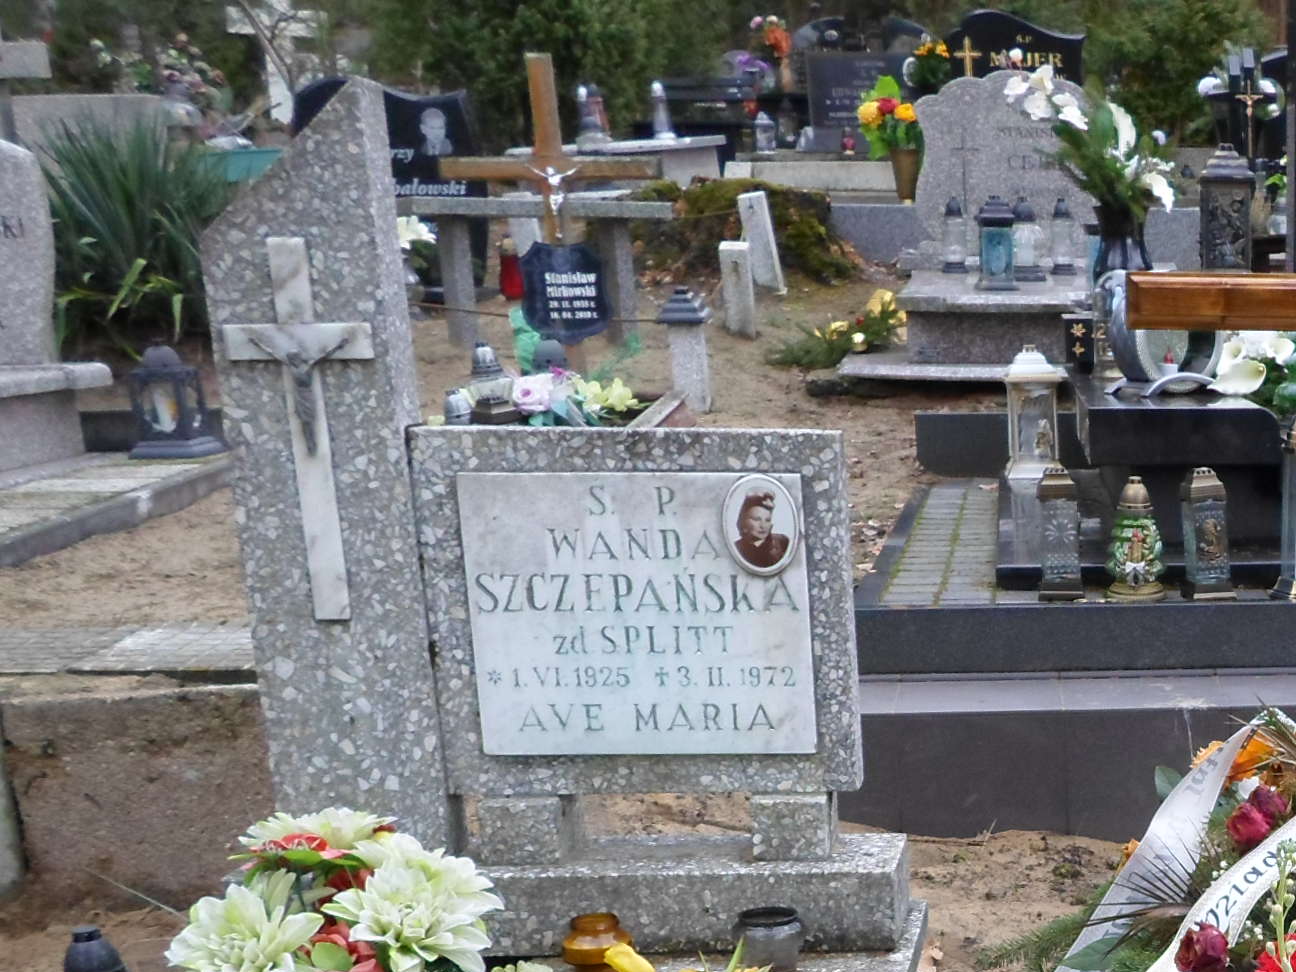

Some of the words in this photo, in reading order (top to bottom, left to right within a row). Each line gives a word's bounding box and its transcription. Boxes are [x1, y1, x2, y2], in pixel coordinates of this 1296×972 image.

[990, 50, 1063, 67] MJER
[546, 528, 721, 561] WANDA
[474, 566, 800, 615] SZCZEPAŃSKA
[600, 625, 734, 655] SPLITT
[519, 703, 605, 732] AVE
[635, 703, 777, 732] MARIA
